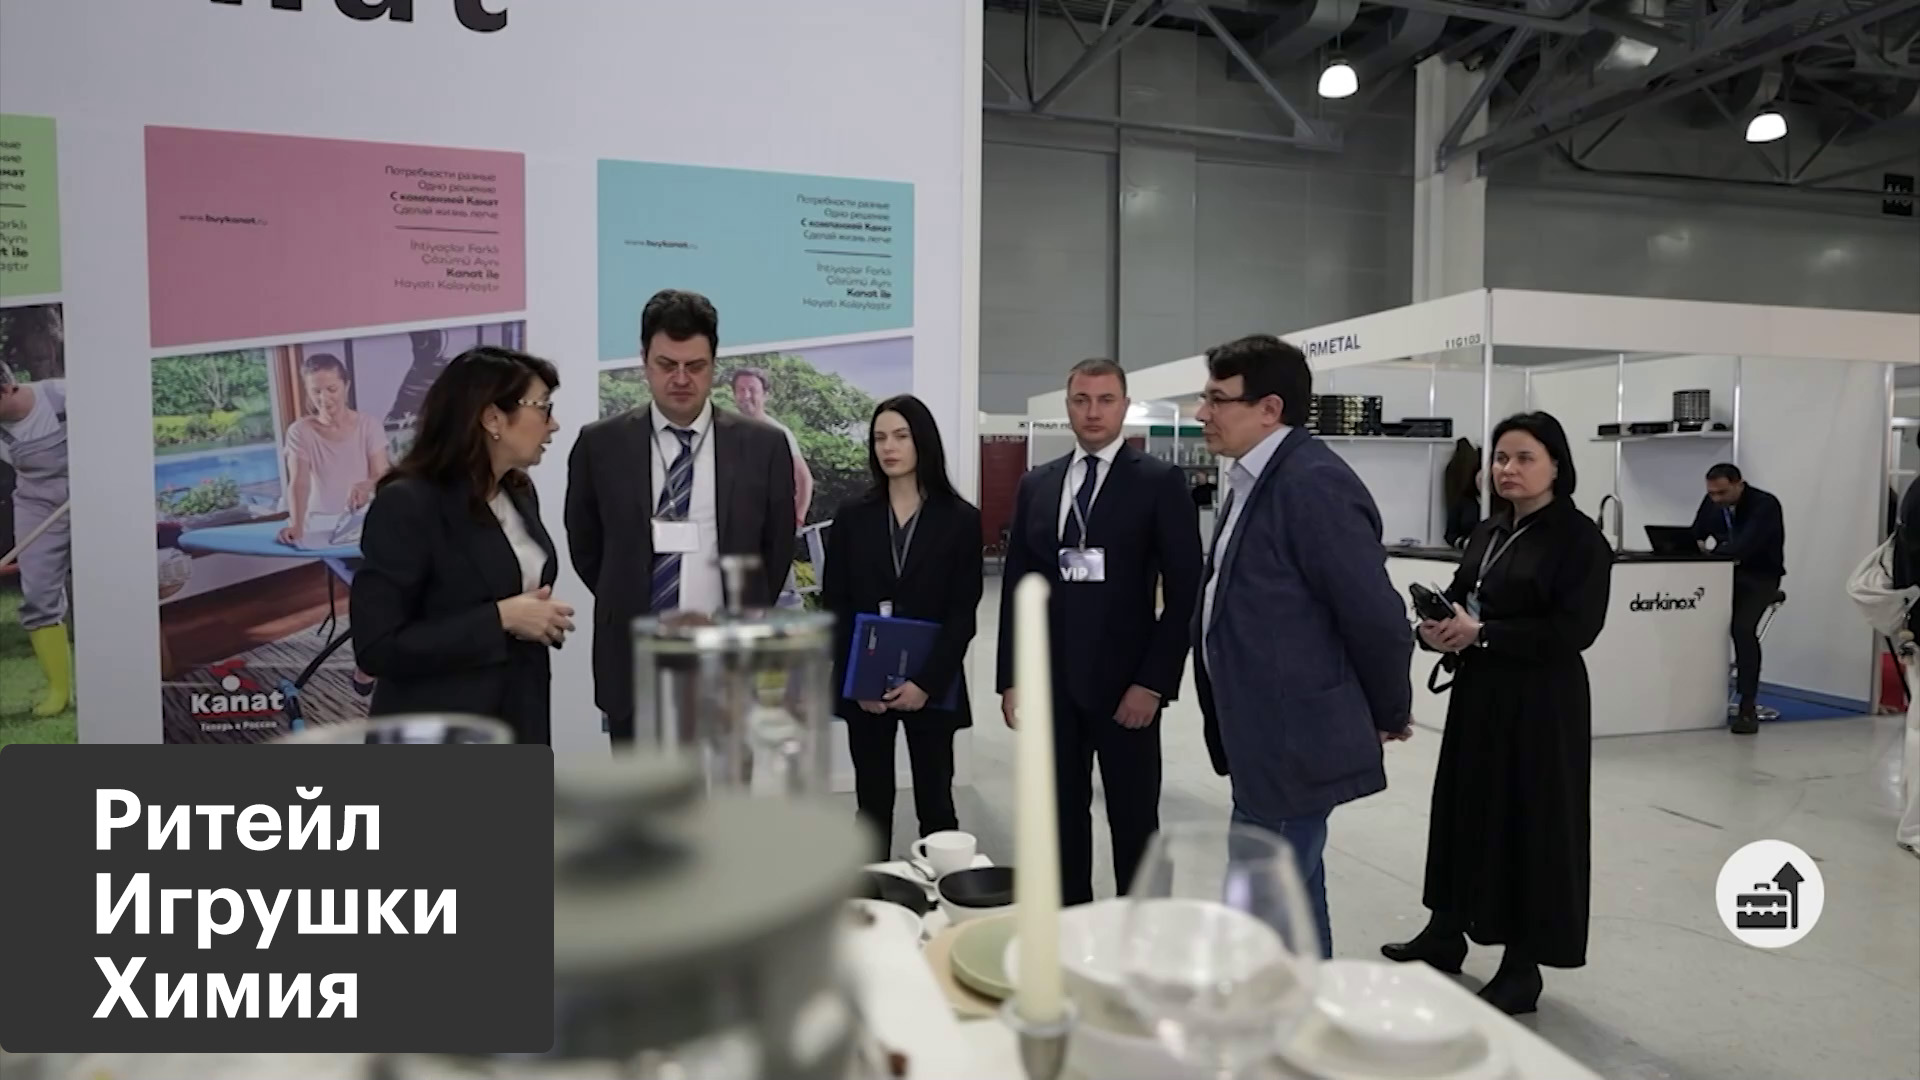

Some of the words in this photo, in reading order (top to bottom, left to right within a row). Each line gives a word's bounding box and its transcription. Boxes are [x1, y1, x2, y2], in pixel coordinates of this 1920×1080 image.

[446, 268, 482, 278] Kanat
[1060, 567, 1089, 582] VIP
[1629, 592, 1697, 612] darkinox
[191, 690, 284, 714] Kanat
